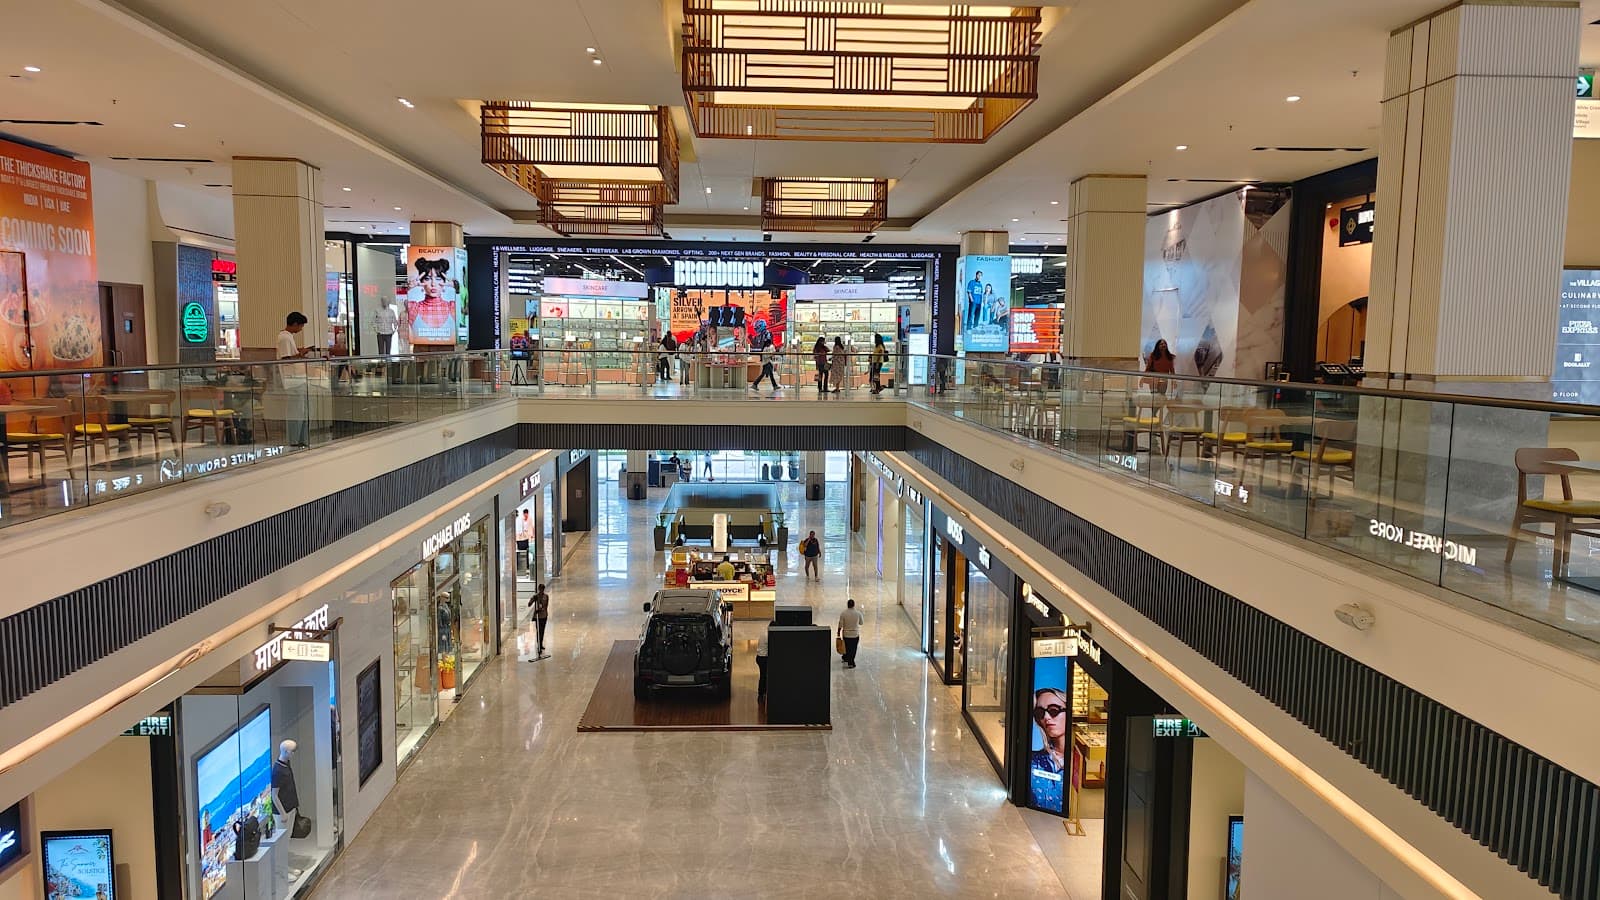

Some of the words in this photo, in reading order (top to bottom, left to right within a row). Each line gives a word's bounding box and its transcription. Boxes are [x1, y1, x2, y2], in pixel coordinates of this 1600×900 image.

[0, 156, 14, 174] THE
[16, 160, 58, 183] THICKSHAKE
[59, 170, 86, 190] FACTORY
[1, 216, 55, 252] COMING
[57, 225, 91, 256] SOON
[674, 260, 764, 287] BROADWAY
[1014, 313, 1035, 322] SHOP.
[422, 526, 453, 559] MICHAEL
[453, 513, 471, 537] KORS
[140, 717, 168, 726] FIRE
[1156, 719, 1182, 728] FIRE
[140, 726, 169, 736] EXIT
[1156, 728, 1181, 737] EXIT
